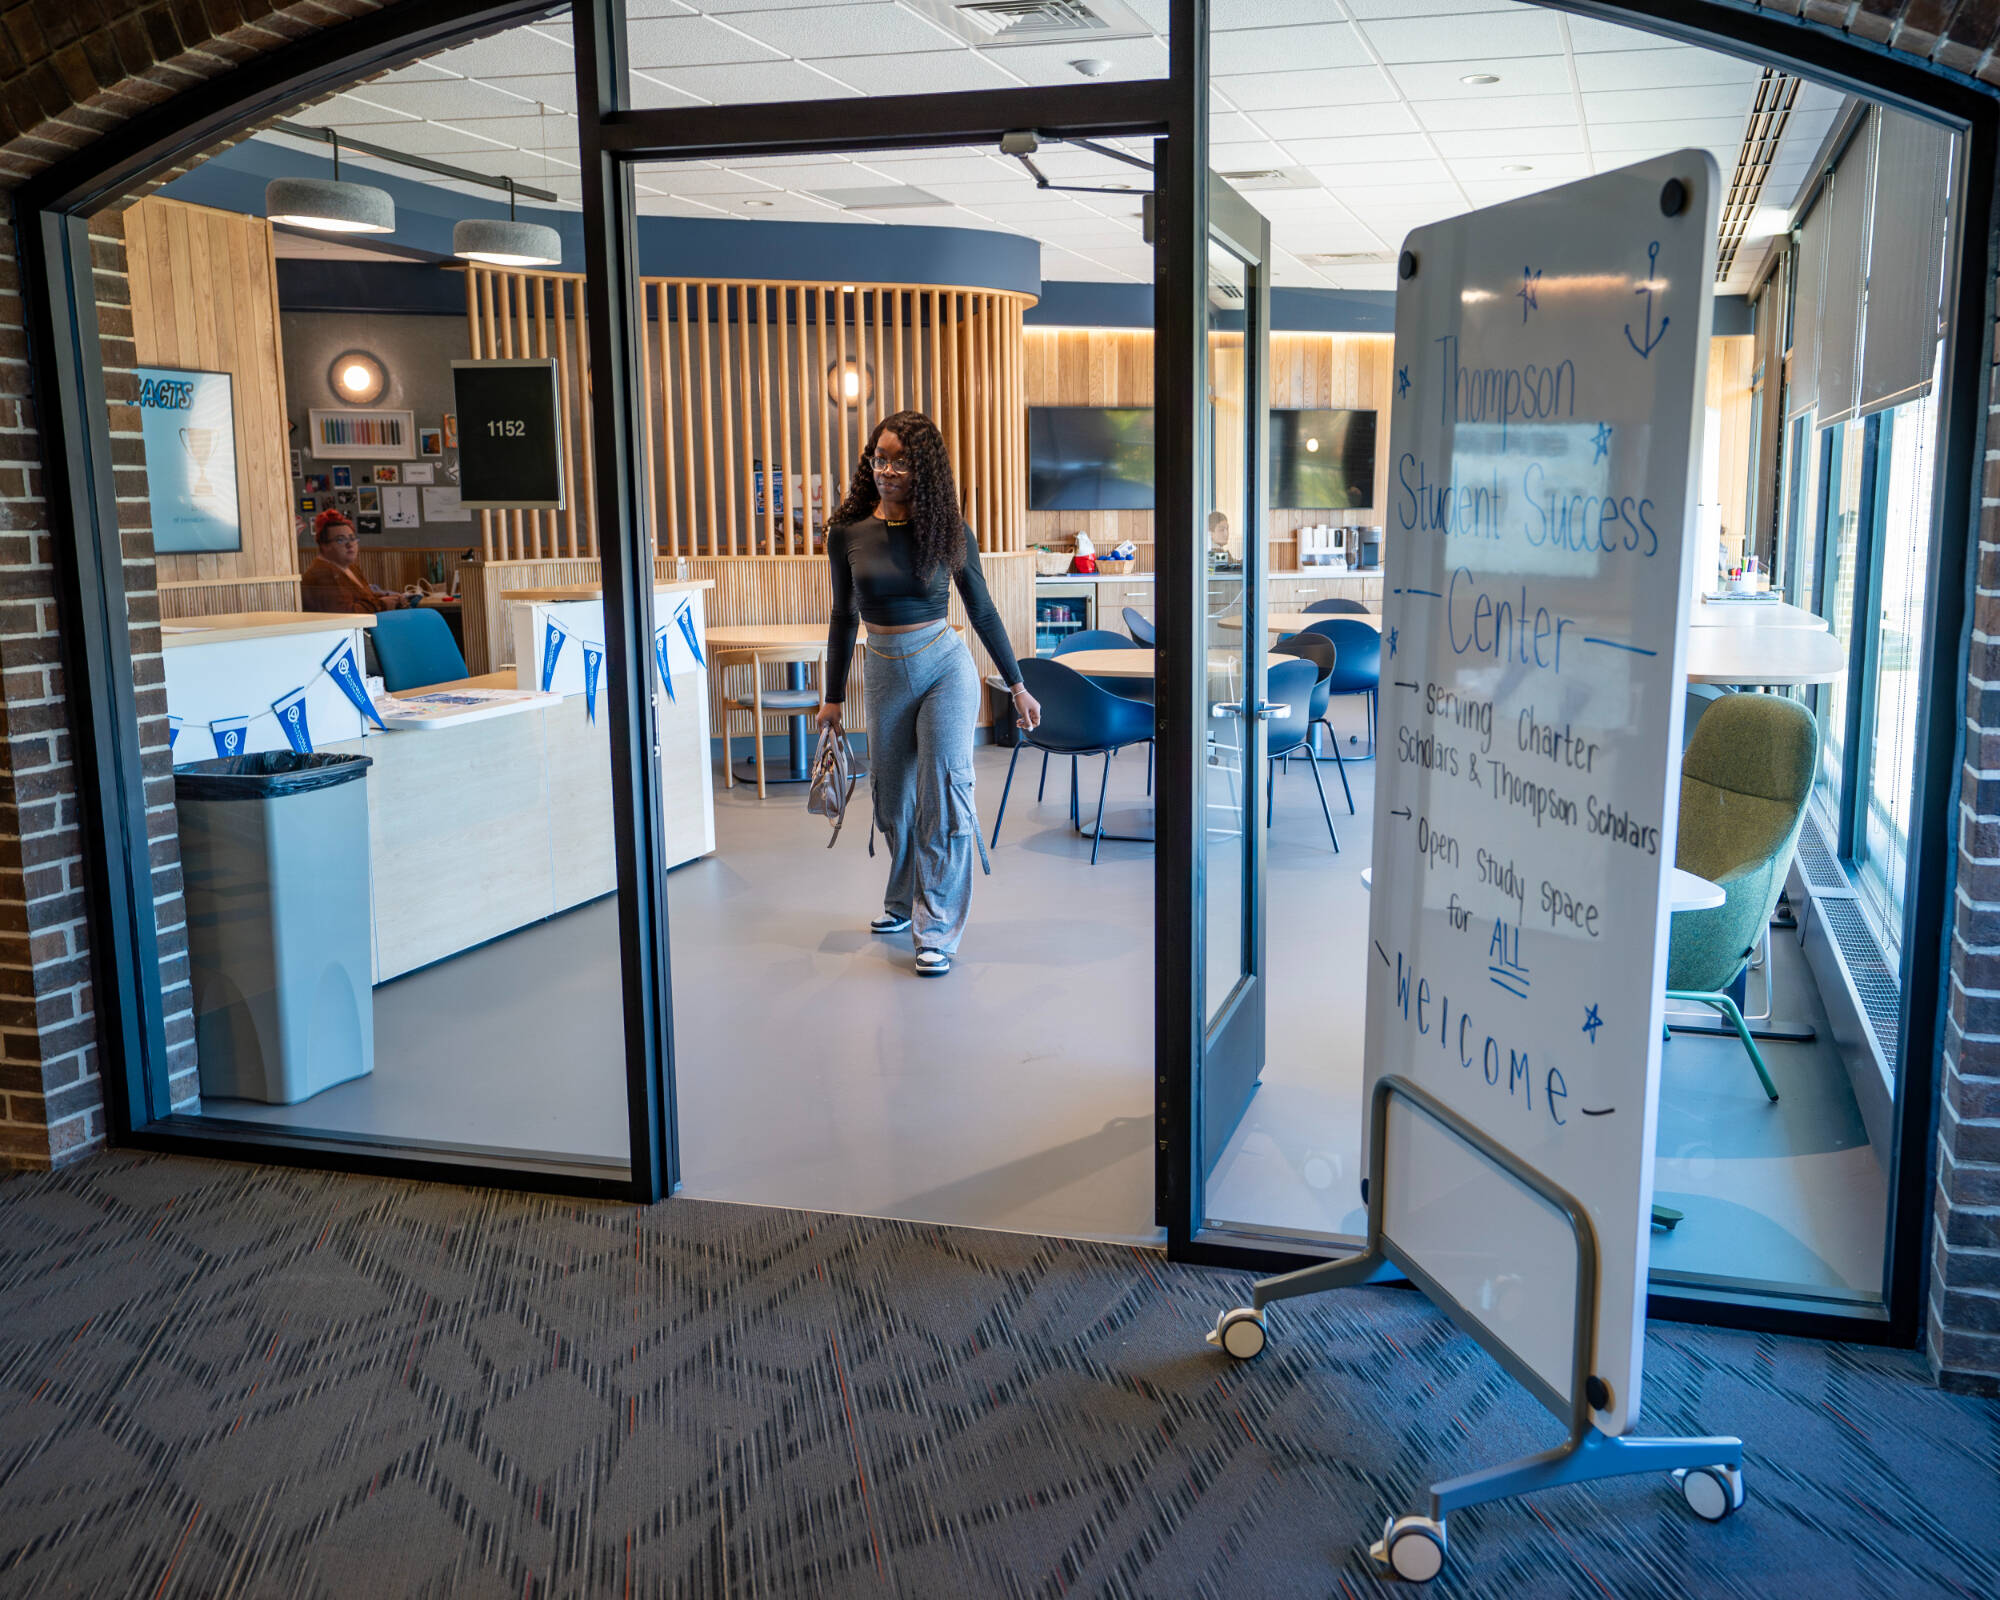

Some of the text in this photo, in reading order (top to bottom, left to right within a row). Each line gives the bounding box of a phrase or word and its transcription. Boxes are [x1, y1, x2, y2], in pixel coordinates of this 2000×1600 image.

[487, 420, 526, 437] 1152
[1435, 335, 1575, 452] Thompson
[1398, 453, 1658, 557] Student Success
[1448, 566, 1575, 675] Center
[1518, 705, 1600, 773] Charter
[1398, 726, 1659, 855] Scholars & Thompson Scholars
[1418, 817, 1459, 870] Open
[1447, 893, 1530, 973] for ALL
